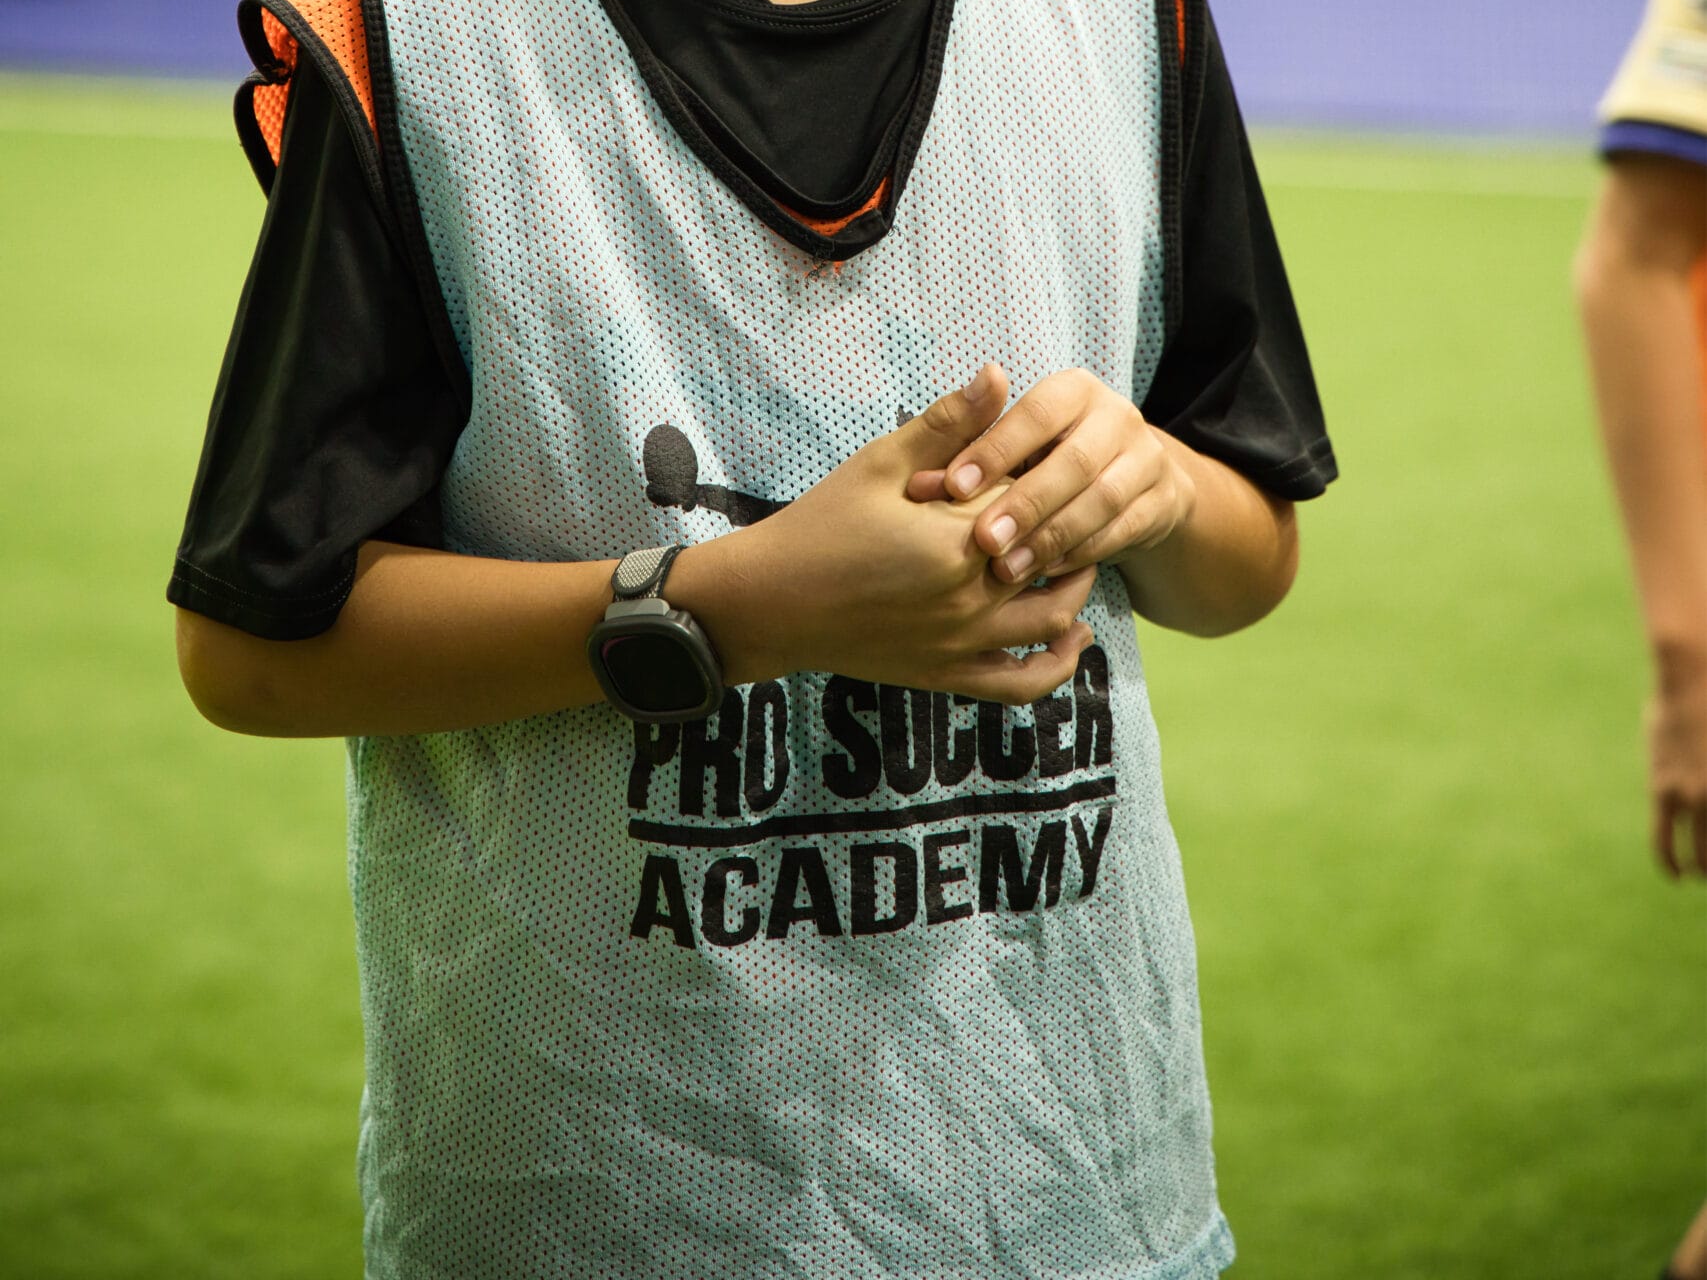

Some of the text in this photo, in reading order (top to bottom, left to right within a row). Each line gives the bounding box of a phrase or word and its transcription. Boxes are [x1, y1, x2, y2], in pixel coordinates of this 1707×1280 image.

[628, 644, 1114, 818] PRO SOCCER
[629, 807, 1114, 949] ACADEMY
